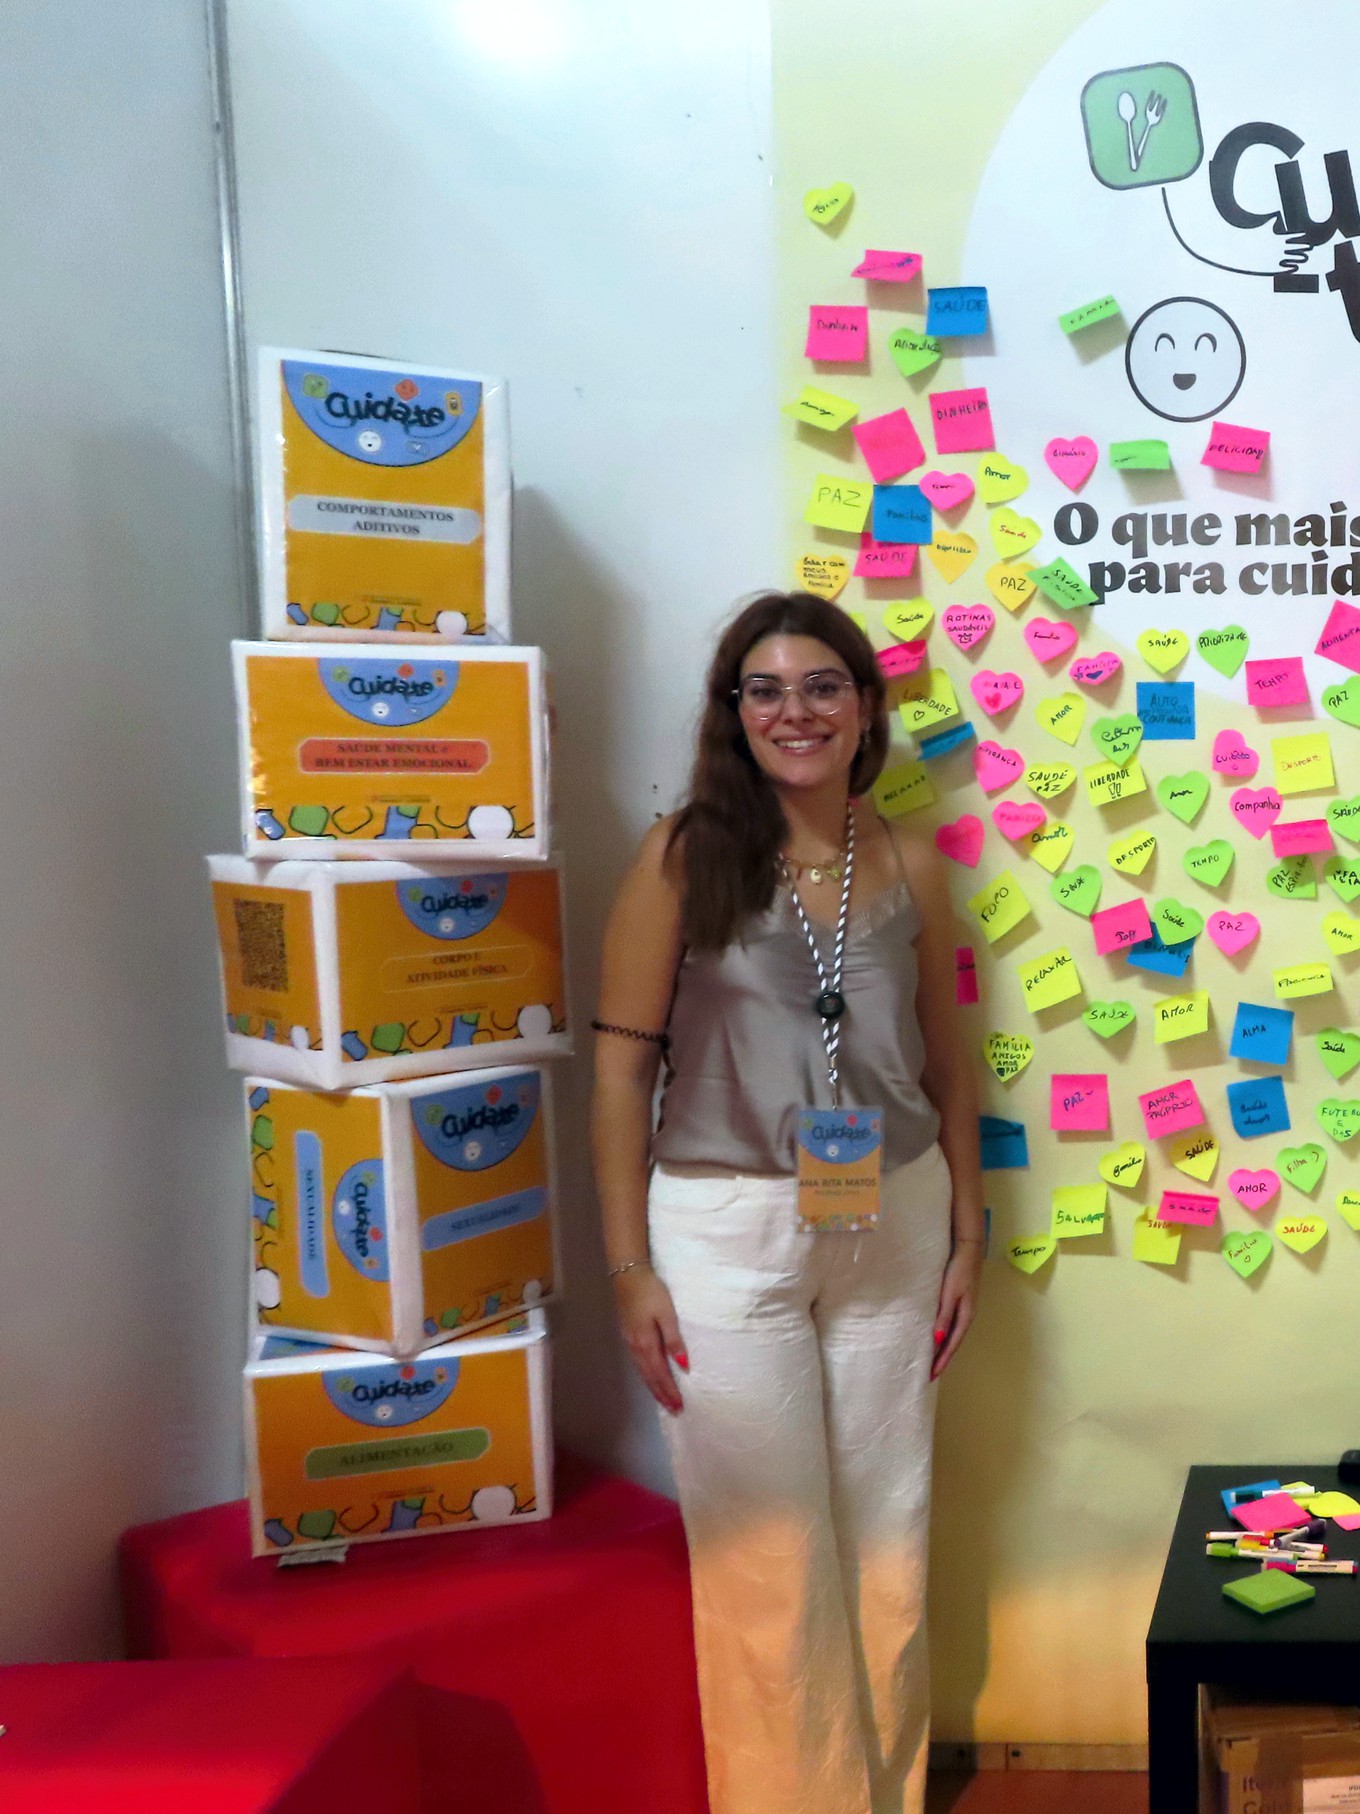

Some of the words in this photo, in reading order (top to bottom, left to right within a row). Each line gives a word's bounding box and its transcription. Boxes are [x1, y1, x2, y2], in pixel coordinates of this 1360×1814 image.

[818, 487, 862, 508] PAZ
[317, 501, 454, 522] COMPORTAMENTOS
[353, 521, 420, 535] ADITIVOS
[1053, 502, 1099, 546] O
[1111, 511, 1222, 559] que
[1000, 577, 1027, 591] PAZ
[1088, 560, 1227, 606] para
[947, 614, 991, 623] ROTINAS
[1255, 673, 1289, 690] TEMPO
[903, 689, 951, 715] LIBERDADE
[1051, 704, 1072, 725] AMOR
[385, 743, 438, 753] MENTAL
[315, 758, 345, 768] BEM
[348, 758, 390, 768] ESTAR
[394, 758, 471, 768] EMOCIONAL
[1089, 768, 1130, 789] LIBERDADE
[1191, 854, 1220, 868] TEMPO
[1218, 920, 1246, 931] PAZ
[433, 954, 472, 966] CORPO
[1161, 1004, 1194, 1020] AMOR
[1242, 1025, 1267, 1039] ALMA
[1148, 1092, 1178, 1109] AMOR
[1237, 1182, 1267, 1194] AMOR
